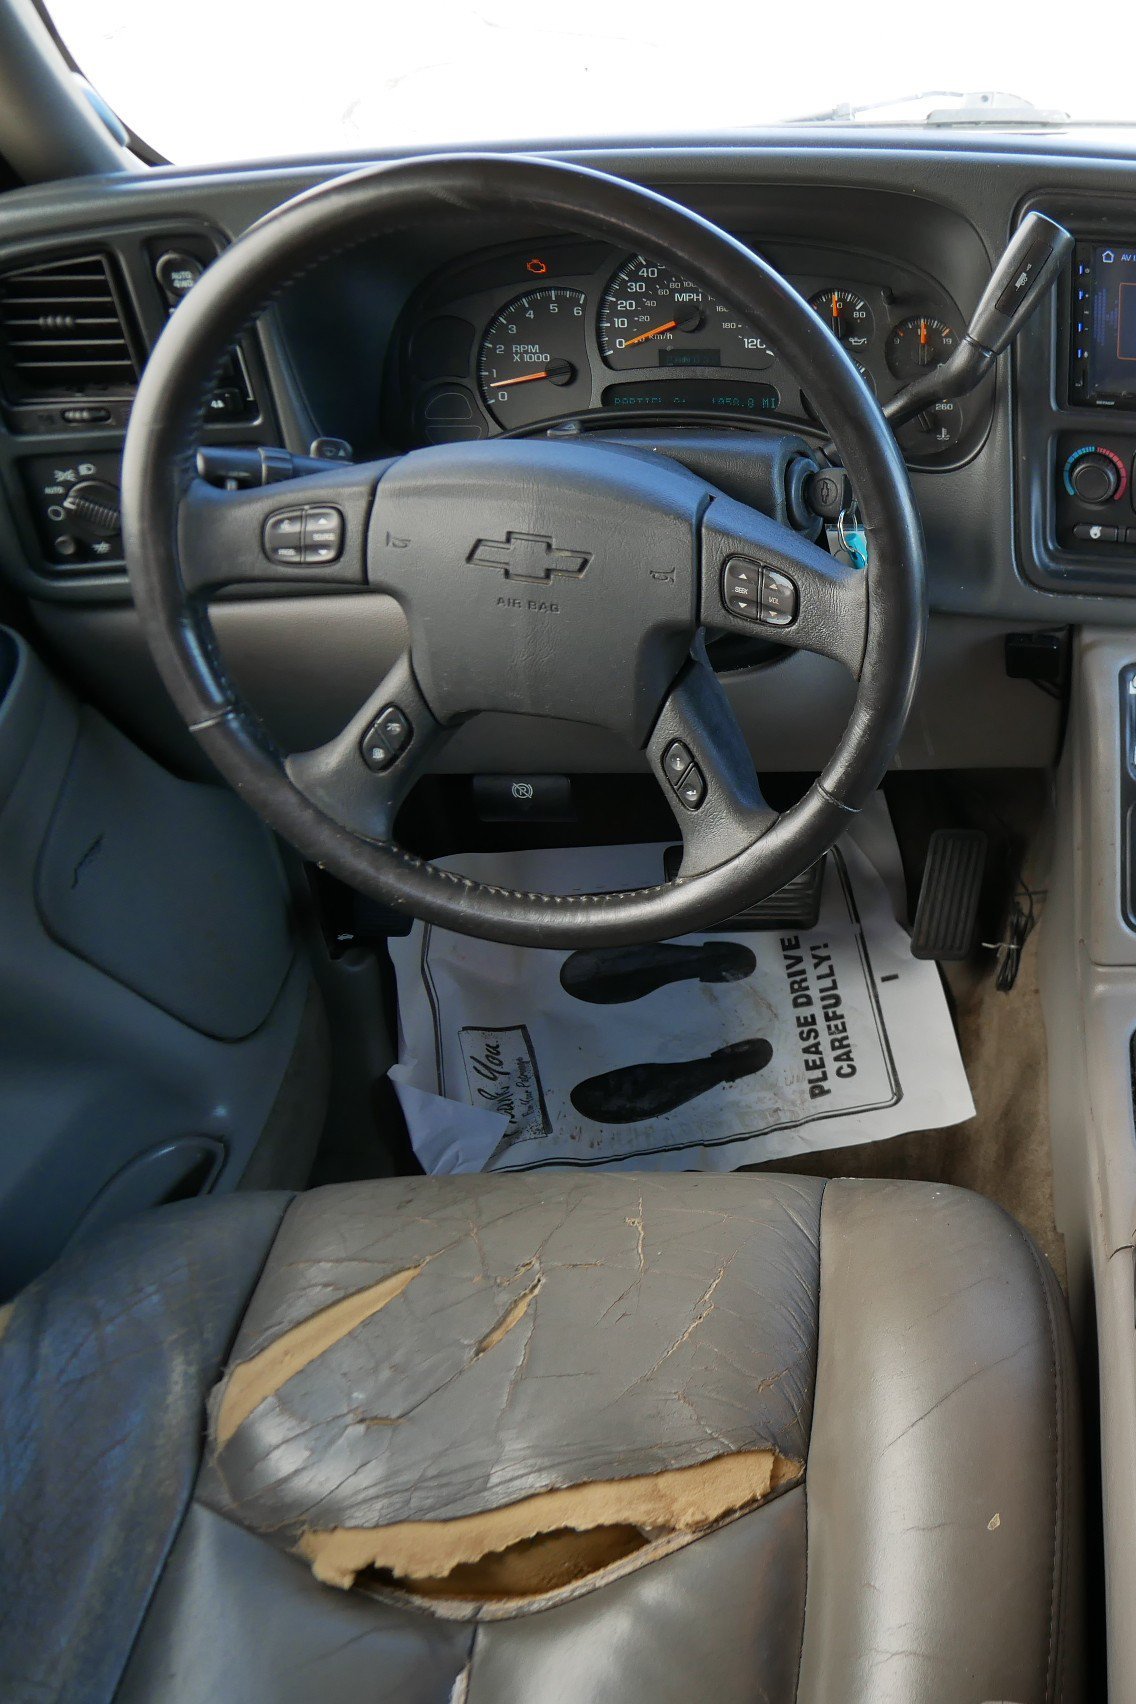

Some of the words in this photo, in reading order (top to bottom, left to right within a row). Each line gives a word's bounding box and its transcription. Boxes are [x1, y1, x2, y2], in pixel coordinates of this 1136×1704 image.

[1121, 254, 1132, 262] AV
[638, 267, 658, 278] 40
[627, 282, 646, 293] 30
[674, 293, 702, 302] MPH
[549, 303, 559, 313] 5
[617, 300, 636, 311] 20
[525, 310, 535, 320] 4
[573, 306, 583, 316] 6
[853, 311, 866, 319] 80
[613, 317, 628, 328] 10
[508, 324, 517, 334] 3
[496, 344, 505, 354] 2
[512, 344, 540, 353] RPM
[616, 339, 626, 349] 0
[513, 353, 521, 362] X
[523, 353, 550, 362] 1000
[492, 368, 497, 378] 1
[498, 391, 508, 402] 0
[935, 403, 953, 411] 260
[497, 596, 521, 608] AIR
[528, 600, 559, 613] BAG
[780, 935, 814, 1009] DRIVE
[809, 942, 857, 1079] CAREFULLY!
[796, 1013, 832, 1100] PLEASE
